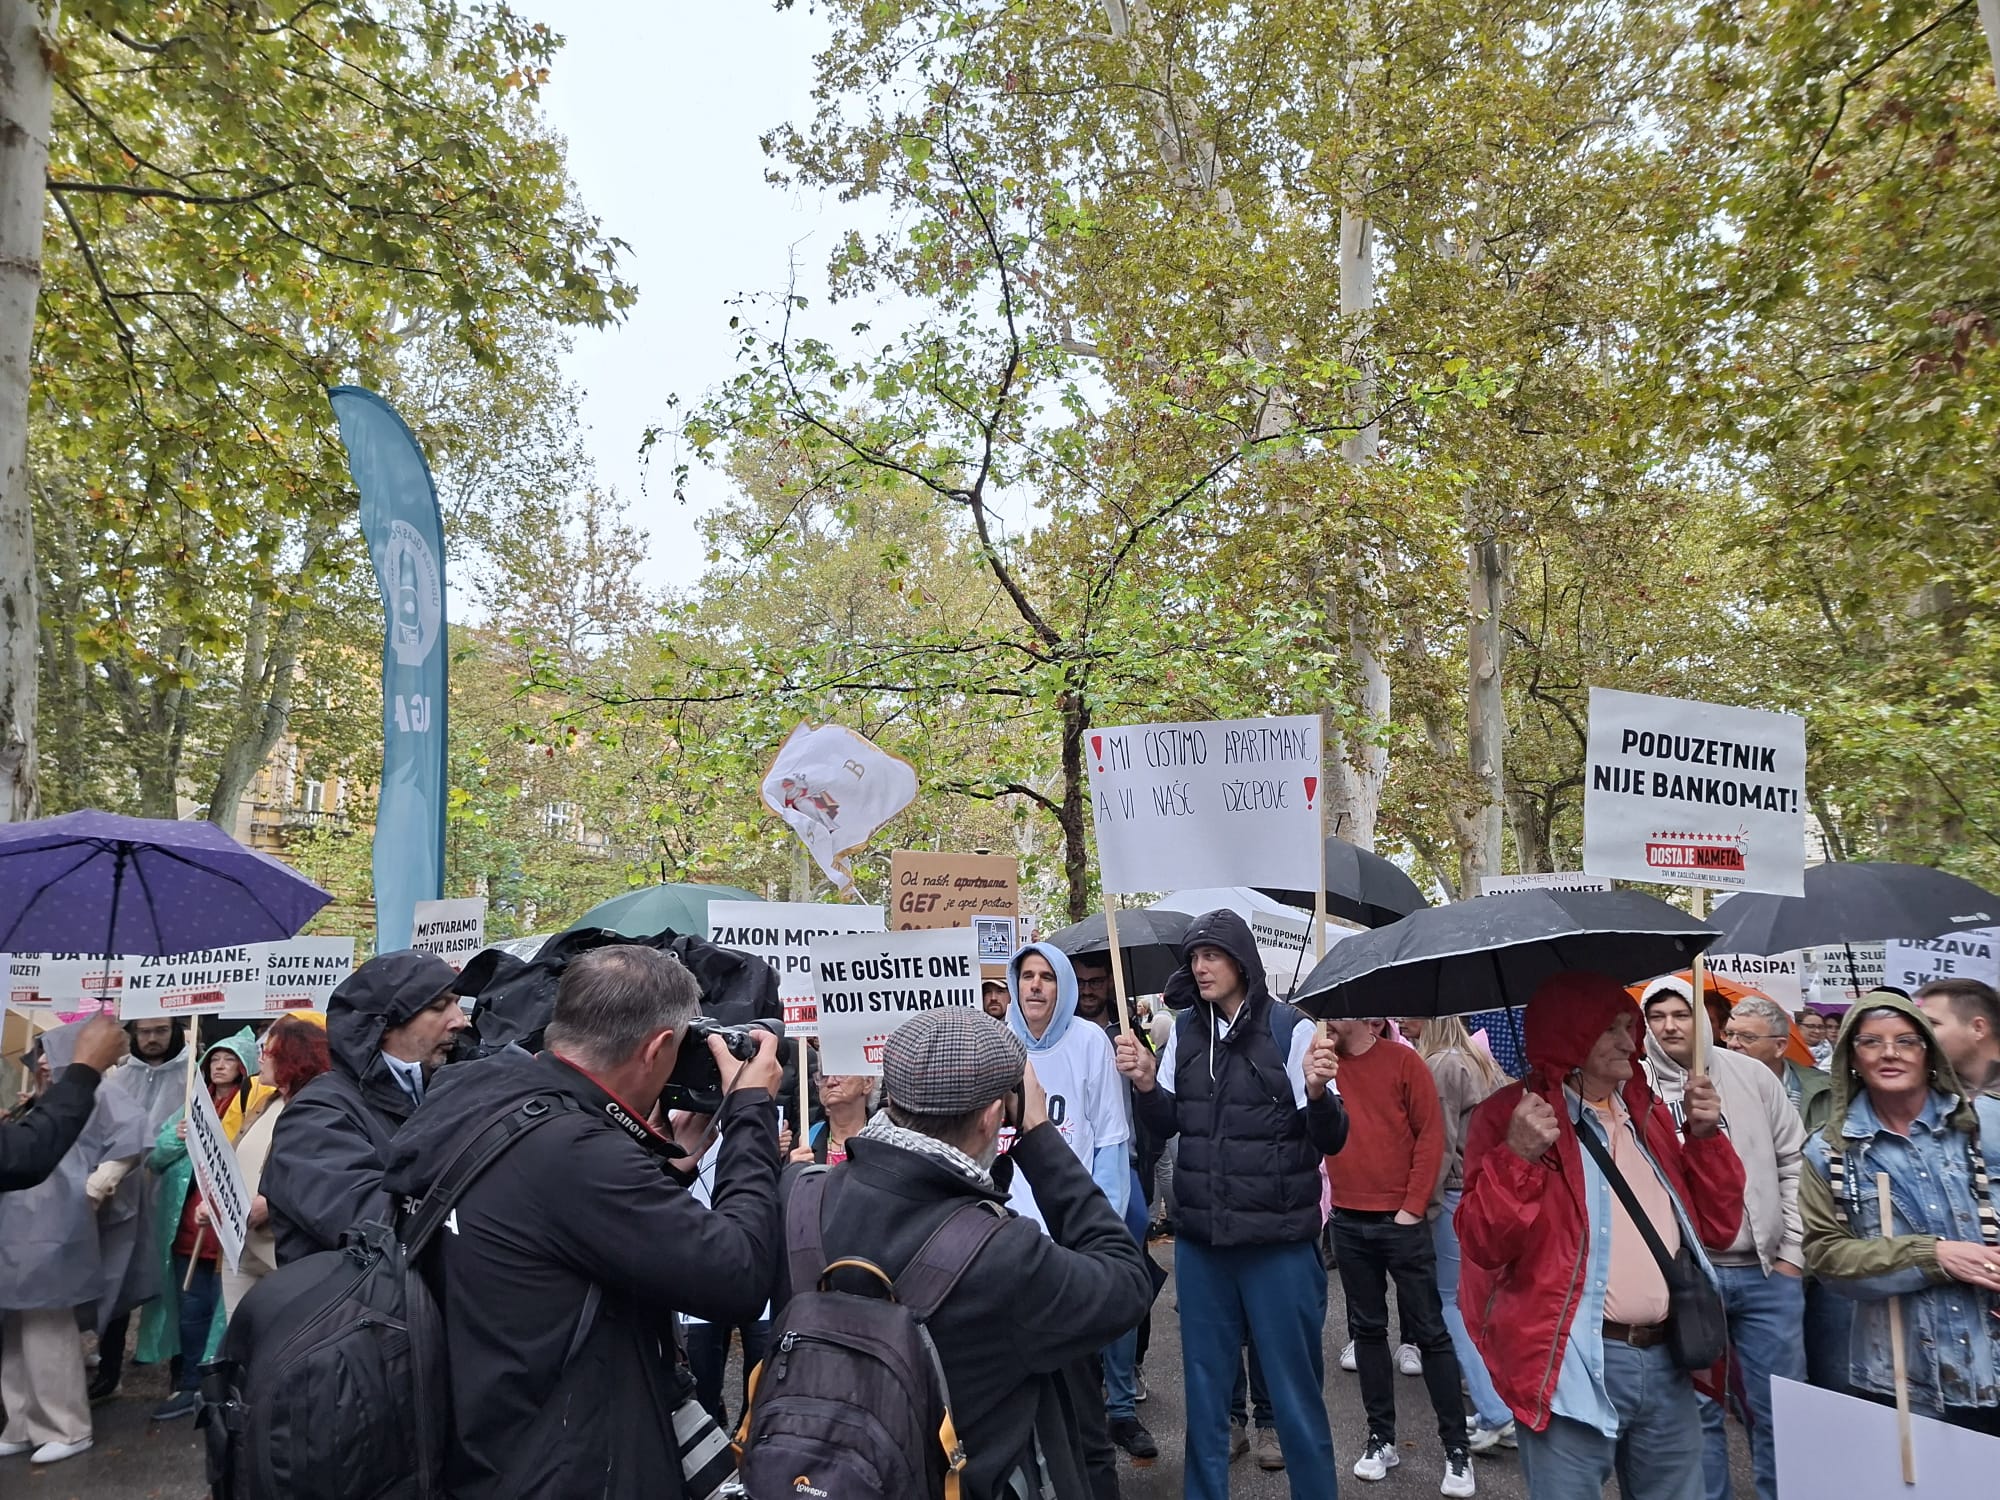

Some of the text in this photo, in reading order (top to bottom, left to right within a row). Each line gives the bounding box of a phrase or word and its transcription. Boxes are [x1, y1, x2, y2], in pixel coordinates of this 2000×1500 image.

[1109, 735, 1131, 772] MI
[1621, 728, 1777, 773] PODUZETNIK
[1593, 764, 1799, 814] NIJE BANKOMAT!
[1098, 791, 1113, 824] A
[1118, 787, 1136, 821] VI
[1650, 846, 1740, 866] DOSTA JE NAMETA!
[901, 871, 919, 886] Od
[899, 891, 942, 913] GET
[417, 918, 477, 938] MI STVARAMO
[712, 926, 779, 946] ZAKON
[1252, 923, 1273, 936] PRVO
[445, 937, 482, 953] RASIPA!
[140, 947, 252, 968] ZA GRAĐANE,
[313, 956, 350, 969] NAM
[820, 952, 970, 982] NE GUŠITE ONE
[1731, 960, 1796, 975] RASIPA!
[1932, 958, 1956, 974] JE
[129, 967, 260, 990] NE ZA UHLJEBE!
[1827, 964, 1842, 973] ZA
[1823, 977, 1838, 986] NE
[822, 992, 864, 1014] KOJI
[605, 1102, 648, 1140] Canon
[796, 1482, 828, 1498] Lowepro
